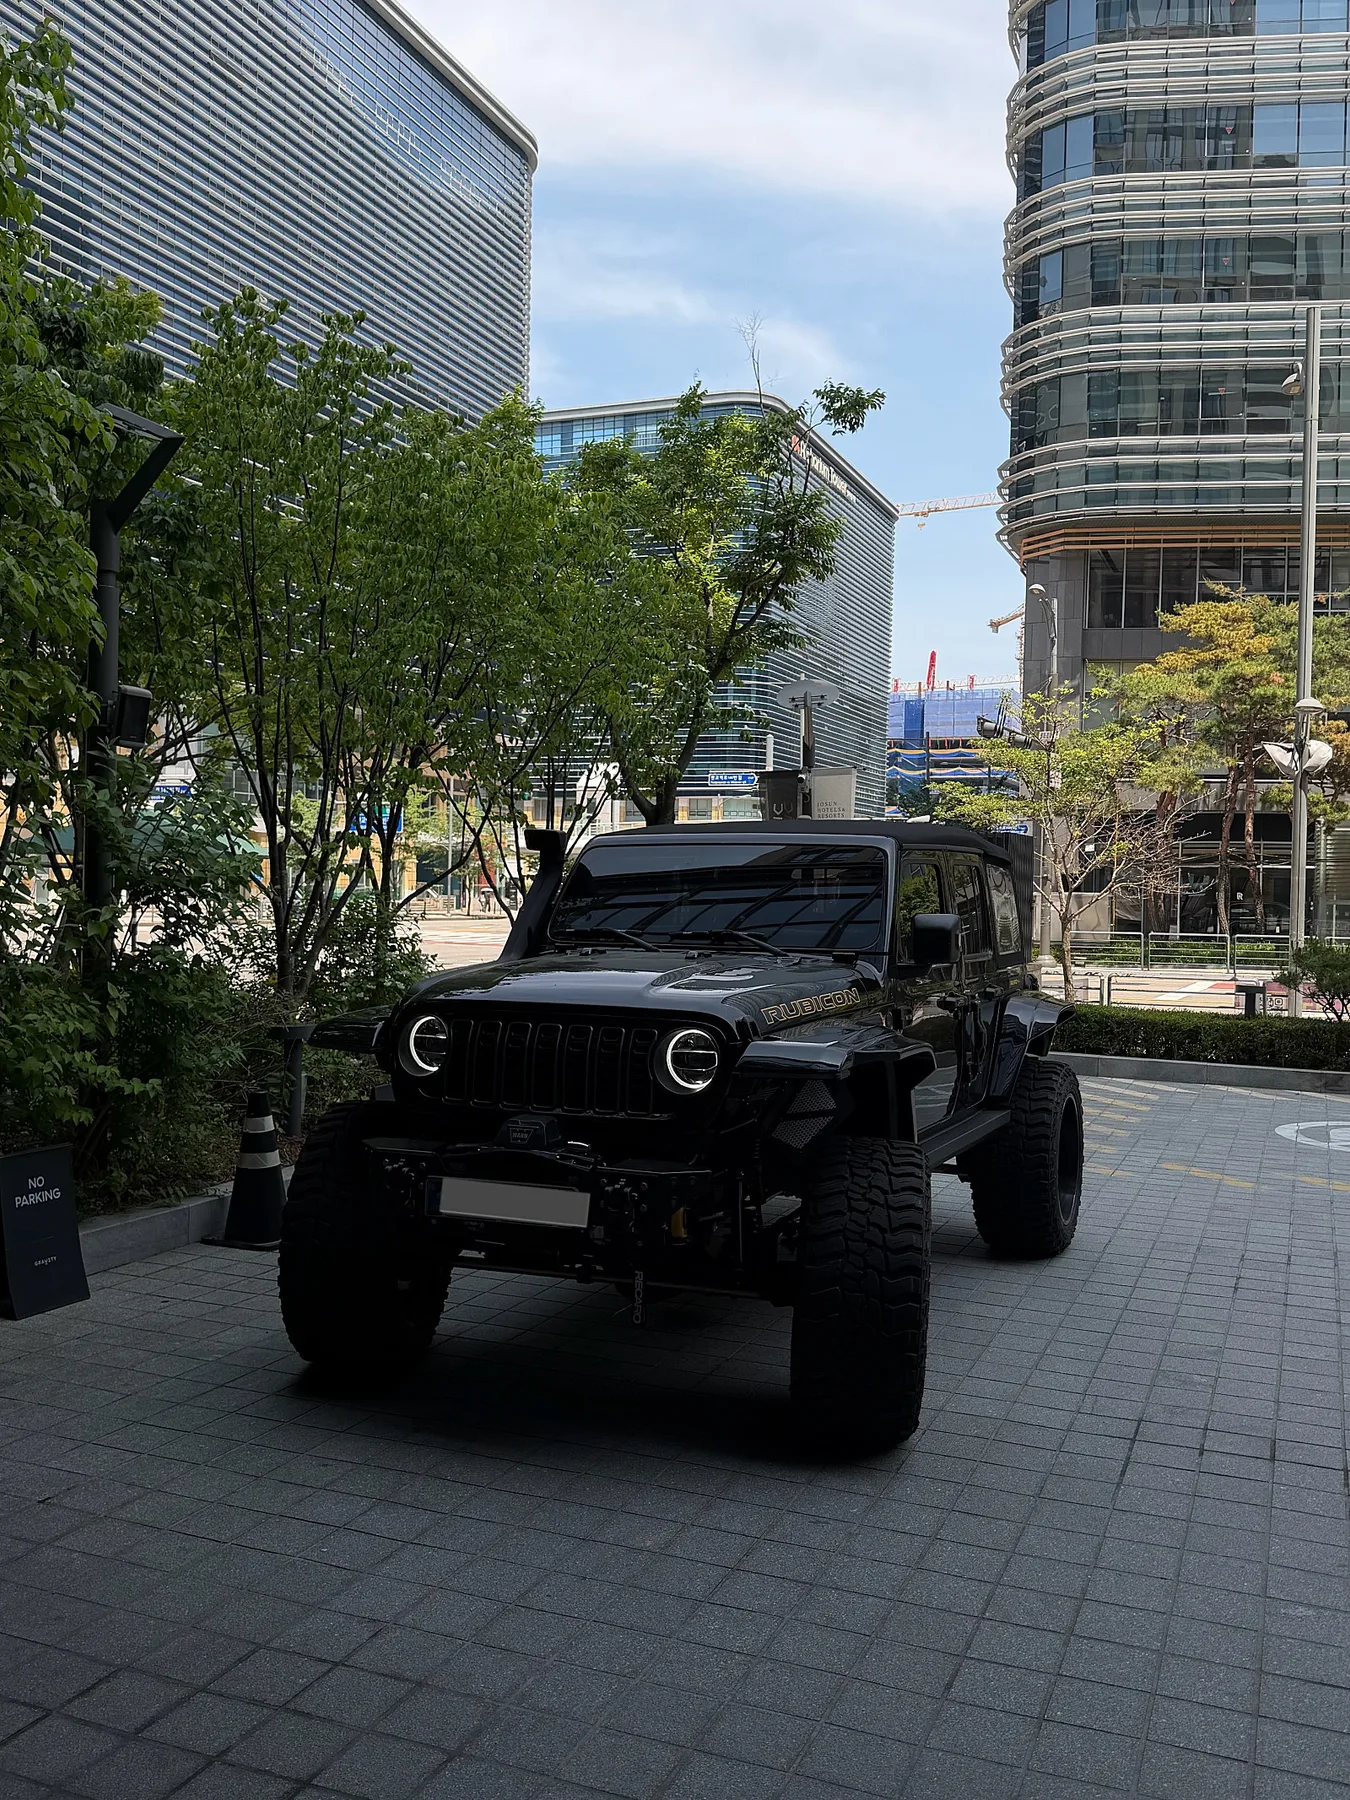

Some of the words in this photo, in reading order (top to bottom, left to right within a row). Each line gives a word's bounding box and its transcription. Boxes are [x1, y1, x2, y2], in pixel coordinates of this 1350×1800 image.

[761, 987, 861, 1025] RUBICON
[14, 1187, 61, 1208] PARKING
[28, 1176, 45, 1190] NO
[632, 1270, 644, 1324] RECARO
